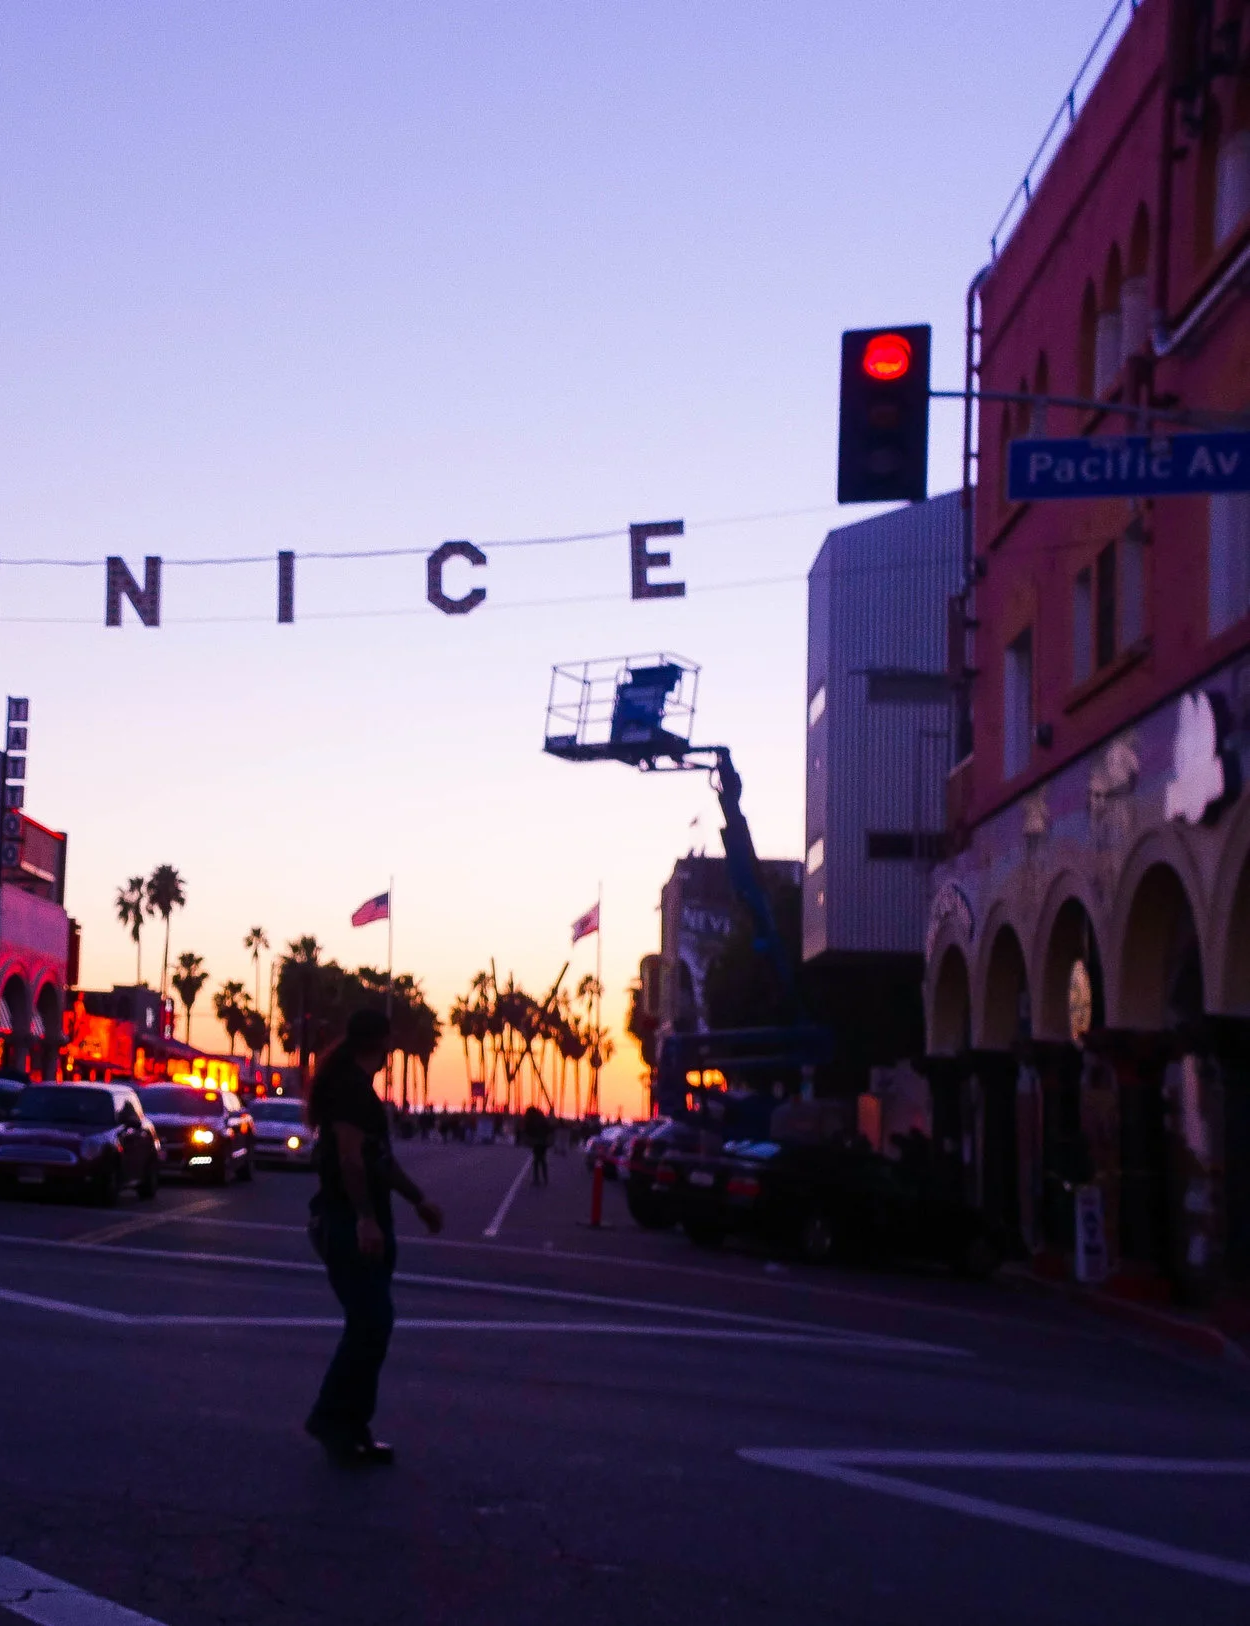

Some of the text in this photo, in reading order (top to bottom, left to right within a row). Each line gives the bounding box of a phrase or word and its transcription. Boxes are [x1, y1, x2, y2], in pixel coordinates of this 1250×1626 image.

[1026, 444, 1242, 484] Pacific Av
[2, 699, 27, 866] TATTOO
